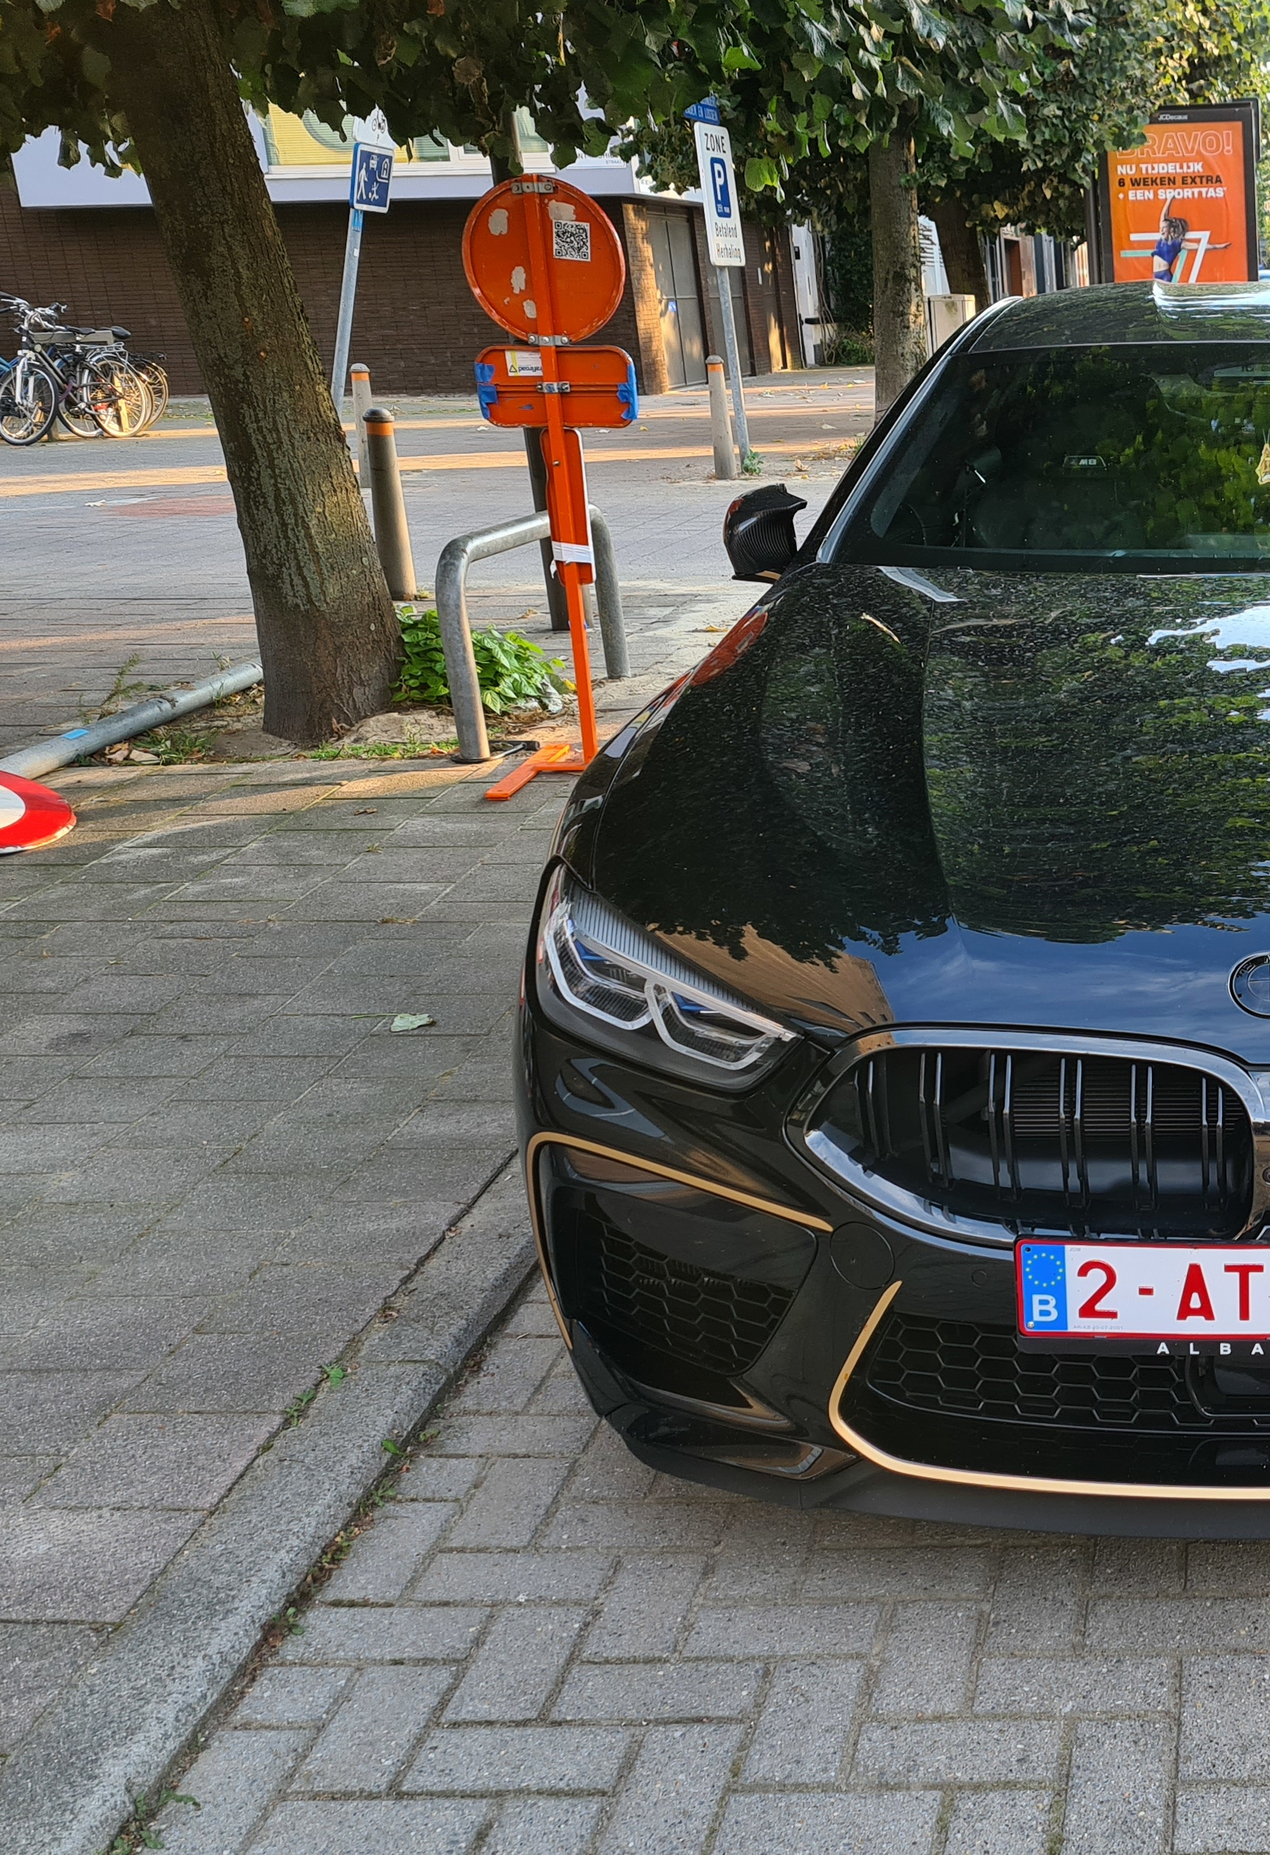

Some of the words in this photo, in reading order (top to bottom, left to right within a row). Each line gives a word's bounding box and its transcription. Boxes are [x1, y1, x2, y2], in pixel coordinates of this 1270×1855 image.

[704, 132, 727, 154] ZONE
[1117, 164, 1136, 175] NU
[1139, 162, 1203, 175] TIJDELIJK
[713, 162, 725, 201] P
[1118, 178, 1126, 187] 6
[1130, 176, 1176, 187] WEKEN
[1181, 175, 1223, 186] EXTRA
[1128, 189, 1154, 200] EEN
[715, 222, 738, 239] Betalend
[1032, 1294, 1059, 1322] B
